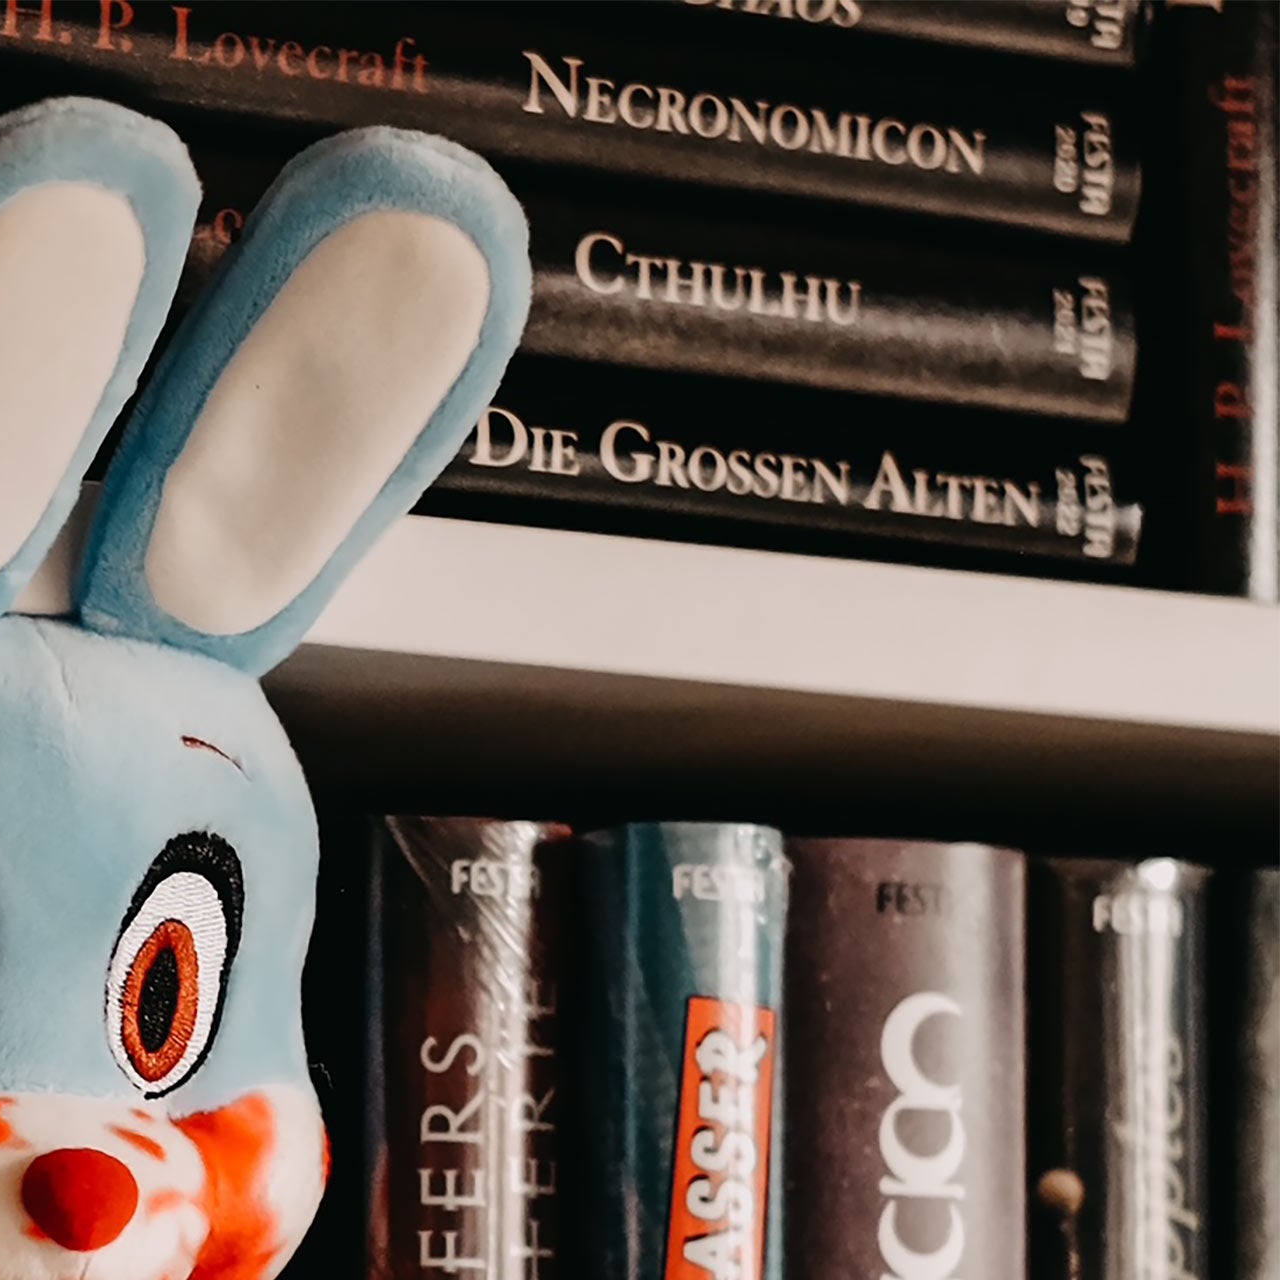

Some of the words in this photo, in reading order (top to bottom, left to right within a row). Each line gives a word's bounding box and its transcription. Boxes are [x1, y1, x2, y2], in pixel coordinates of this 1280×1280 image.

[168, 5, 430, 94] Lovecraft
[522, 51, 986, 177] NECRONOMICON
[1078, 111, 1114, 216] FESTA
[575, 232, 861, 326] CTHULHU
[1078, 276, 1111, 381] FESTA
[467, 406, 580, 478] DIE
[599, 420, 851, 506] GROSSEN
[862, 450, 1043, 529] ALTEN
[1080, 454, 1113, 558] FESTA
